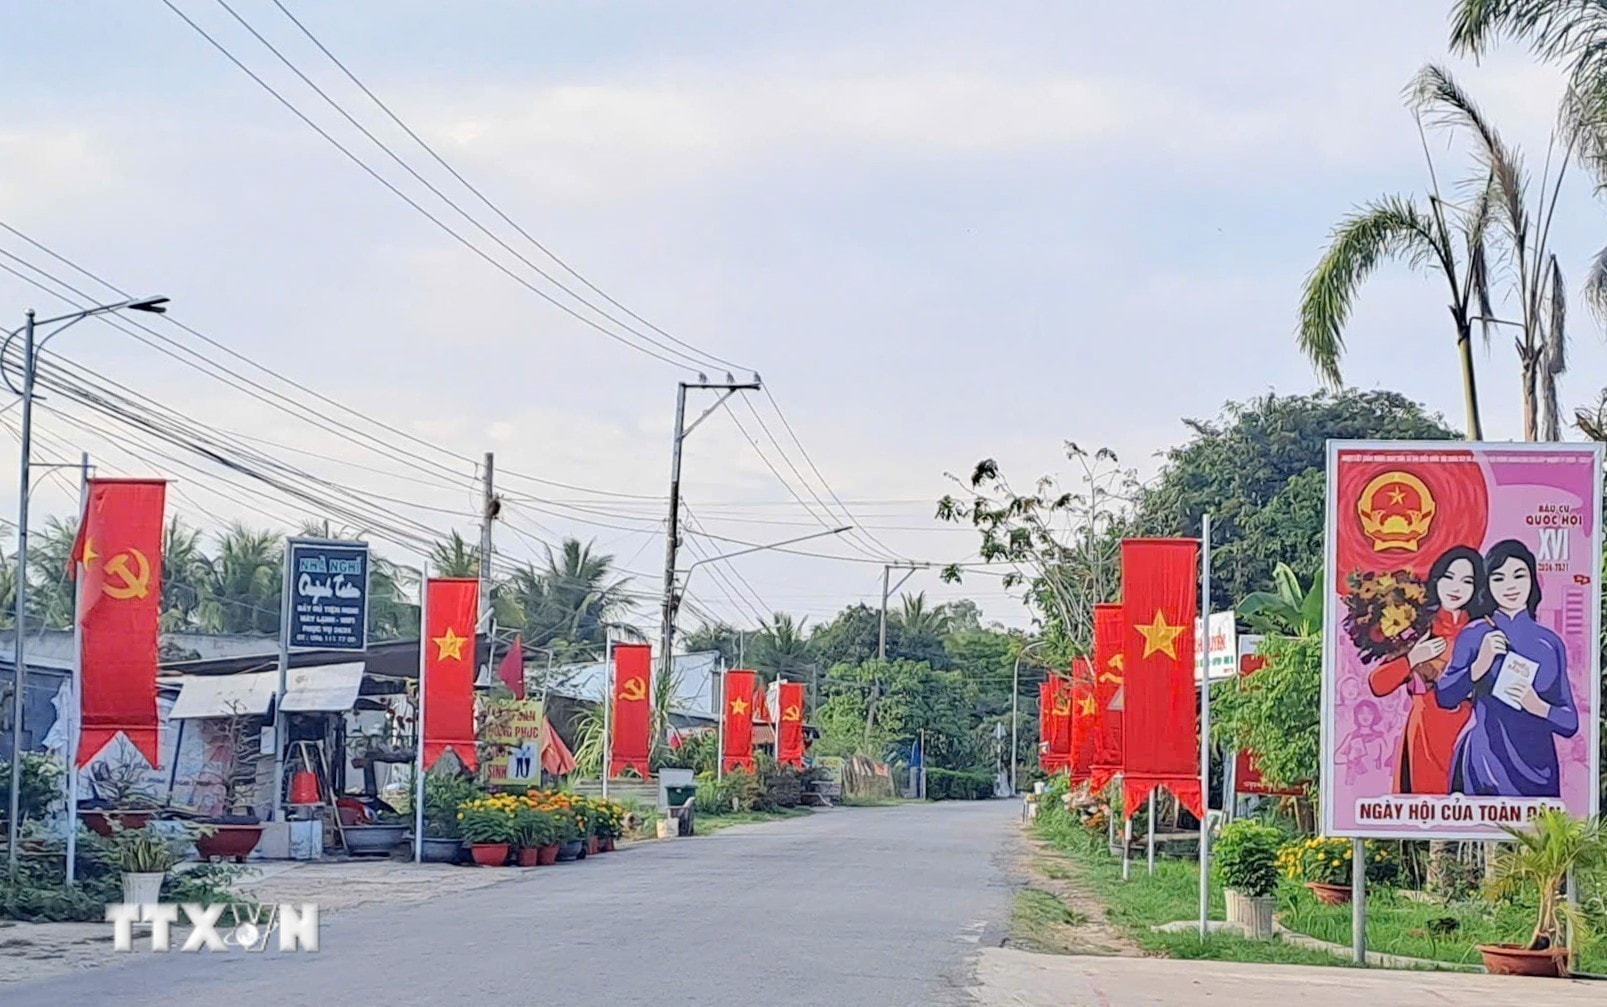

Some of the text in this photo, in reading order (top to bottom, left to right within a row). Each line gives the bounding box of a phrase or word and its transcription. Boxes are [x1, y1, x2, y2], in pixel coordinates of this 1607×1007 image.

[1538, 528, 1569, 560] XVI
[299, 555, 327, 573] NHÀ
[1360, 800, 1402, 820] NGÀY
[1409, 800, 1435, 824] HỘI
[1441, 798, 1474, 821] CỦA
[1479, 801, 1521, 822] TOÀN
